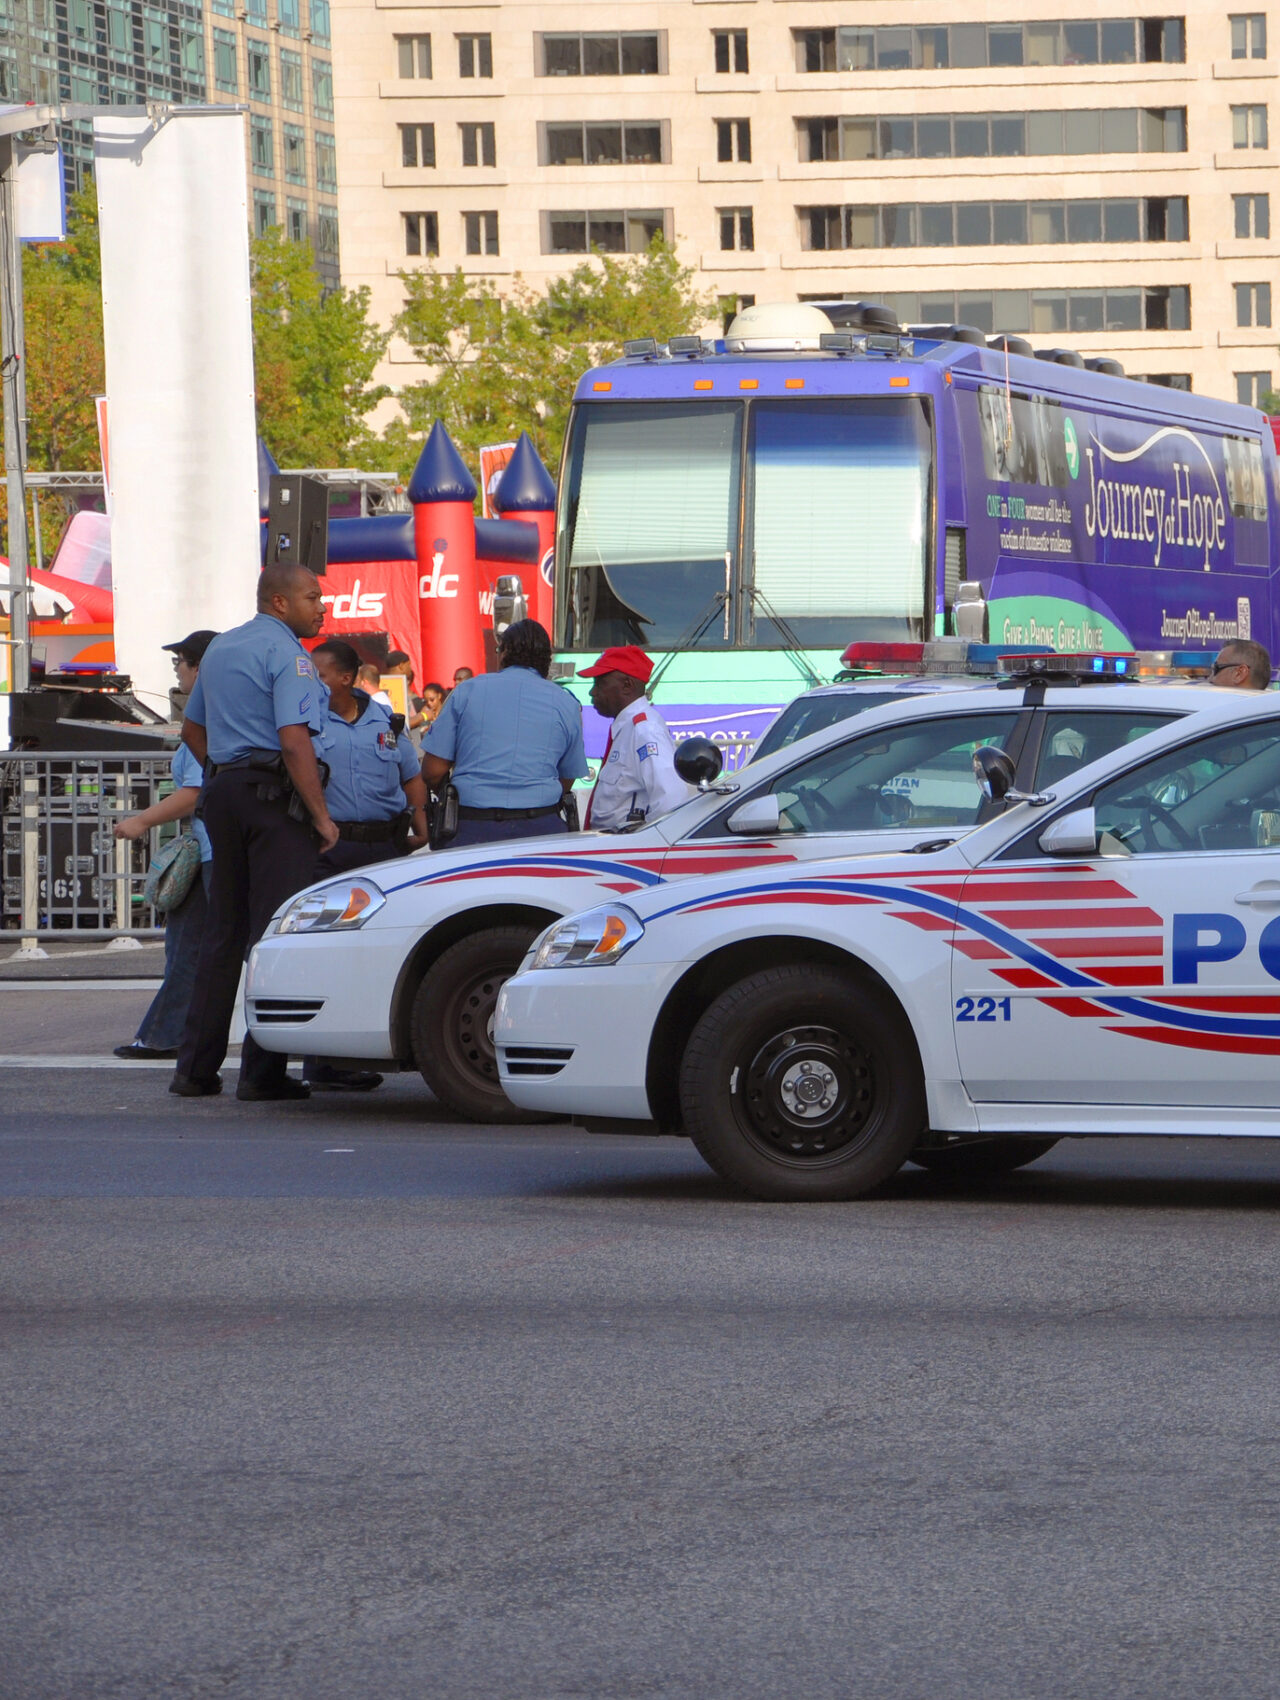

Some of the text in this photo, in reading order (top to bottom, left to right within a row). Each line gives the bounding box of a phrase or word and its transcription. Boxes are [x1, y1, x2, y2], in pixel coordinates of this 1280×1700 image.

[986, 494, 1002, 517] ONE
[1008, 496, 1025, 520] FOUR
[1025, 505, 1045, 521] women
[1062, 501, 1071, 523] the
[1085, 448, 1226, 571] Journey of Hope
[1000, 528, 1018, 549] victim
[1026, 527, 1049, 551] domestic
[1050, 530, 1071, 553] violence
[420, 552, 459, 598] dc
[956, 998, 1011, 1022] 221
